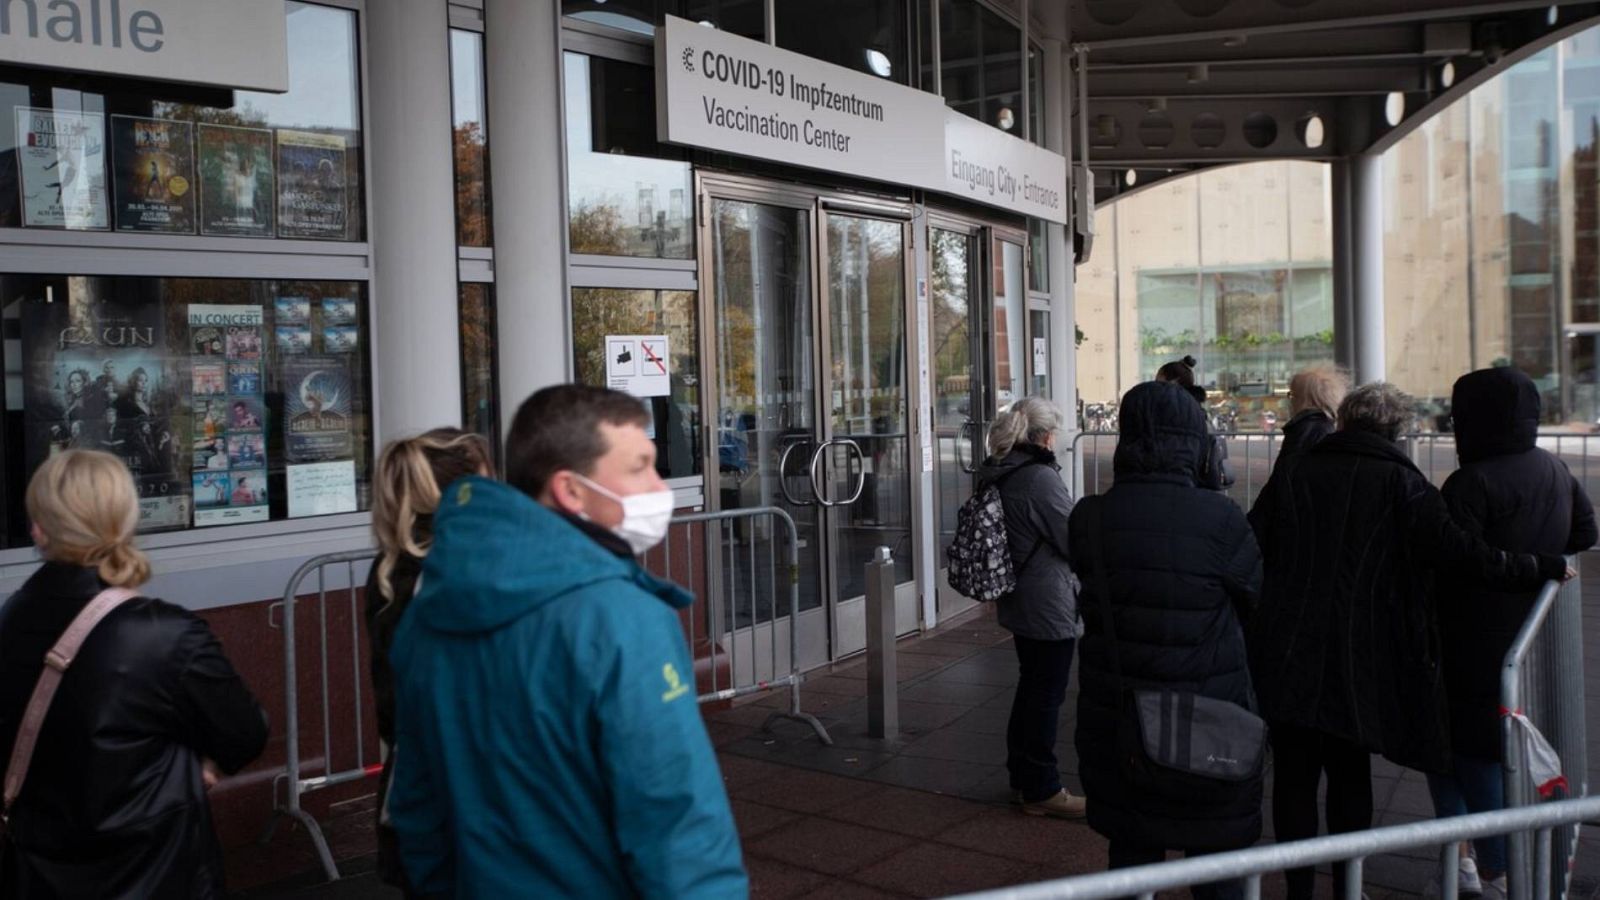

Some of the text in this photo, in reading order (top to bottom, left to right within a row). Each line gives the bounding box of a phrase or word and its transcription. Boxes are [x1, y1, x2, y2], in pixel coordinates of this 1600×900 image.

[702, 50, 884, 122] COVID-19 Impfzentrum
[703, 95, 851, 152] Vaccination Center
[951, 149, 1059, 209] Eingang City Entrance
[190, 313, 261, 326] IN CONCERT
